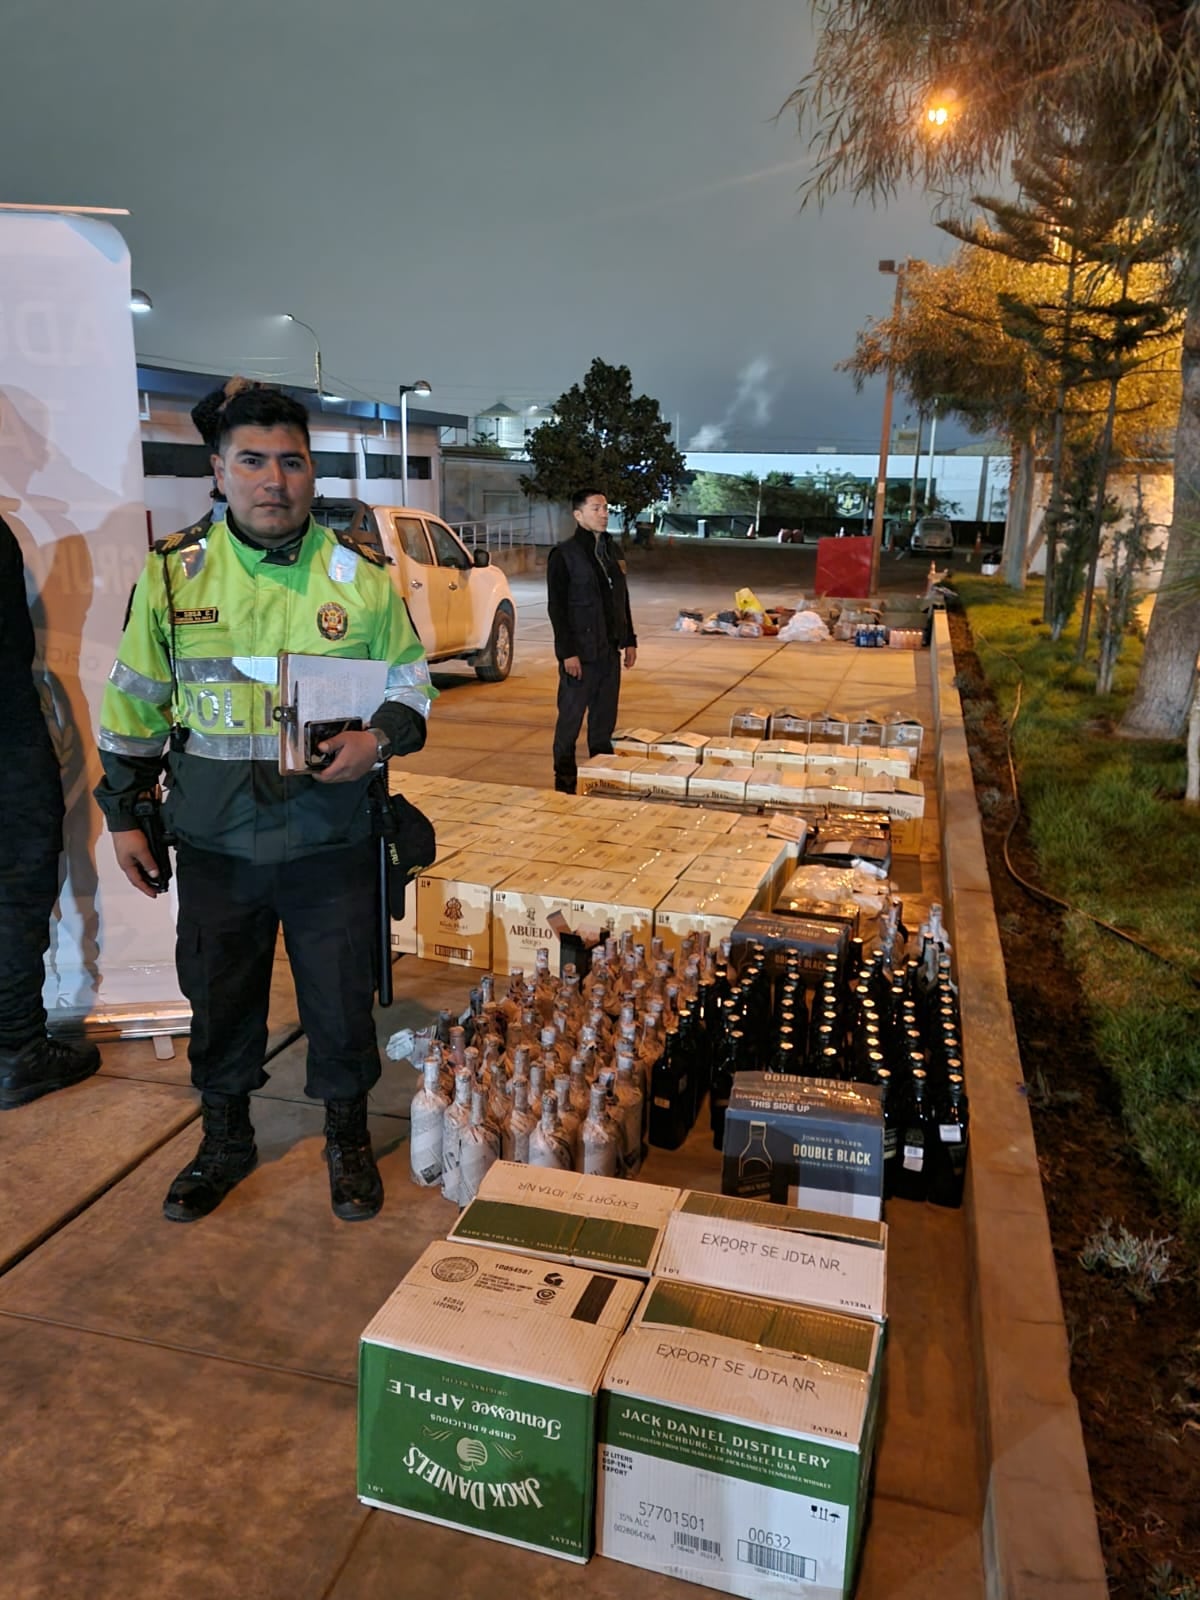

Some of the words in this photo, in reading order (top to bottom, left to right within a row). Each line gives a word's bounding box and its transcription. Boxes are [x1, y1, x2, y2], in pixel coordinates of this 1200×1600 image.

[509, 924, 553, 940] ABUELO
[763, 1072, 810, 1085] DOUBLE
[814, 1077, 853, 1090] BLACK
[750, 1099, 771, 1109] THIS
[772, 1101, 794, 1111] SIDE
[796, 1104, 810, 1113] UP
[793, 1143, 833, 1161] DOUBLE
[837, 1149, 871, 1166] BLACK
[588, 1194, 639, 1210] EXPORT
[701, 1232, 758, 1253] EXPORT
[761, 1245, 778, 1258] SE
[820, 1257, 841, 1271] NR
[840, 1299, 872, 1310] TWELVE
[656, 1343, 720, 1368] EXPORT
[723, 1360, 745, 1376] SE
[792, 1377, 816, 1394] NR
[387, 1379, 465, 1411] APPLE
[472, 1382, 508, 1397] ORIGINAL
[430, 1413, 479, 1432] DELICIOUS
[471, 1400, 562, 1441] Tennessee
[480, 1426, 487, 1434] &
[488, 1428, 517, 1441] CRISP
[810, 1423, 849, 1438] TWELVE
[621, 1408, 662, 1428] JACK
[667, 1419, 726, 1444] DANIEL
[732, 1435, 831, 1470] DISTILLERY
[610, 1452, 633, 1463] LITERS
[651, 1428, 712, 1451] LYNCHBURG,
[714, 1445, 774, 1467] TENNESSEE,
[777, 1461, 797, 1473] USA
[402, 1445, 486, 1511] DANIEL'S
[602, 1464, 627, 1477] EXPORT
[768, 1469, 802, 1484] TENNESSEE
[490, 1477, 544, 1510] JACK
[635, 1516, 649, 1528] ALC
[639, 1501, 705, 1532] 57701501
[549, 1534, 583, 1549] TWELVE
[748, 1527, 791, 1551] 00632
